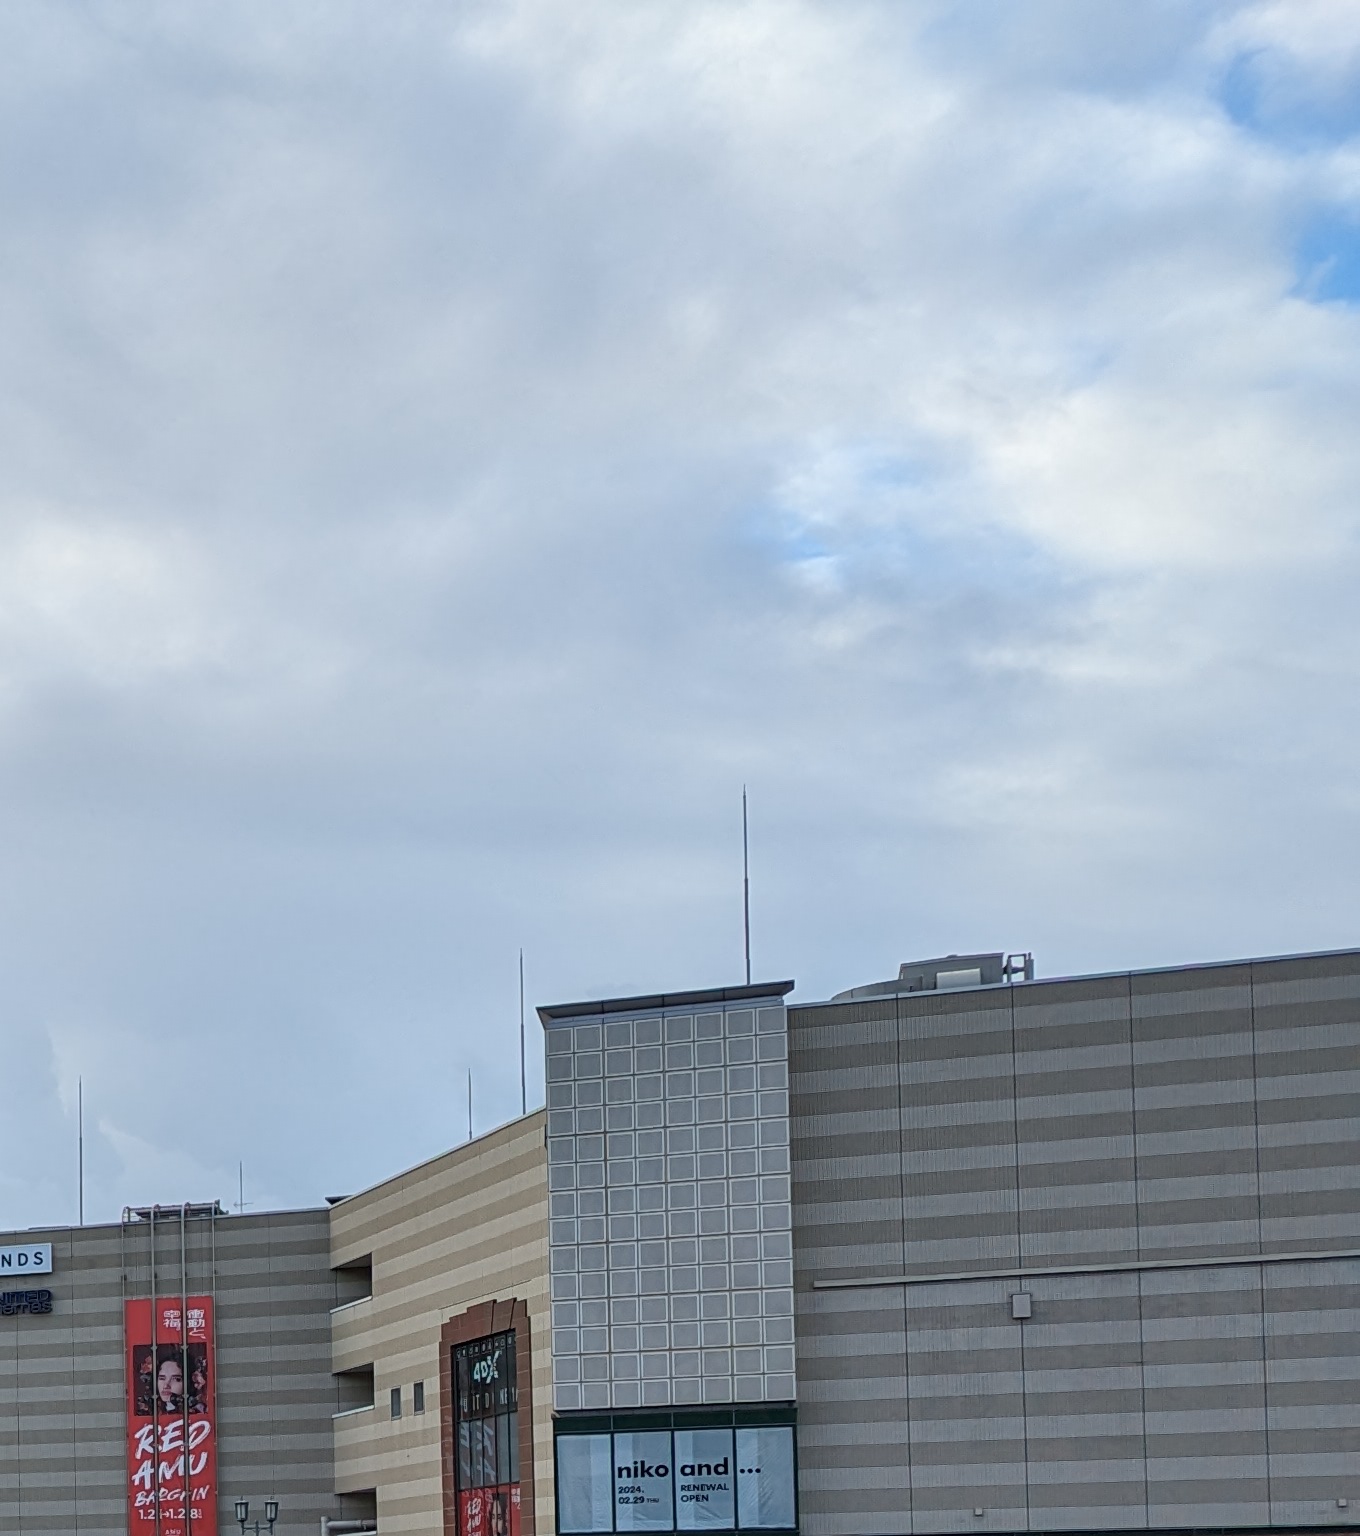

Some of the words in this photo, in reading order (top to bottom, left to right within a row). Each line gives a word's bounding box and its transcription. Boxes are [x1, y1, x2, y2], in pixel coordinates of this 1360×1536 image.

[134, 1420, 212, 1460] RED
[132, 1451, 209, 1490] AMU
[617, 1460, 669, 1478] niko
[680, 1457, 729, 1477] and
[680, 1482, 729, 1492] RENEWAL
[618, 1496, 645, 1505] 02.29
[680, 1494, 709, 1503] OPEN
